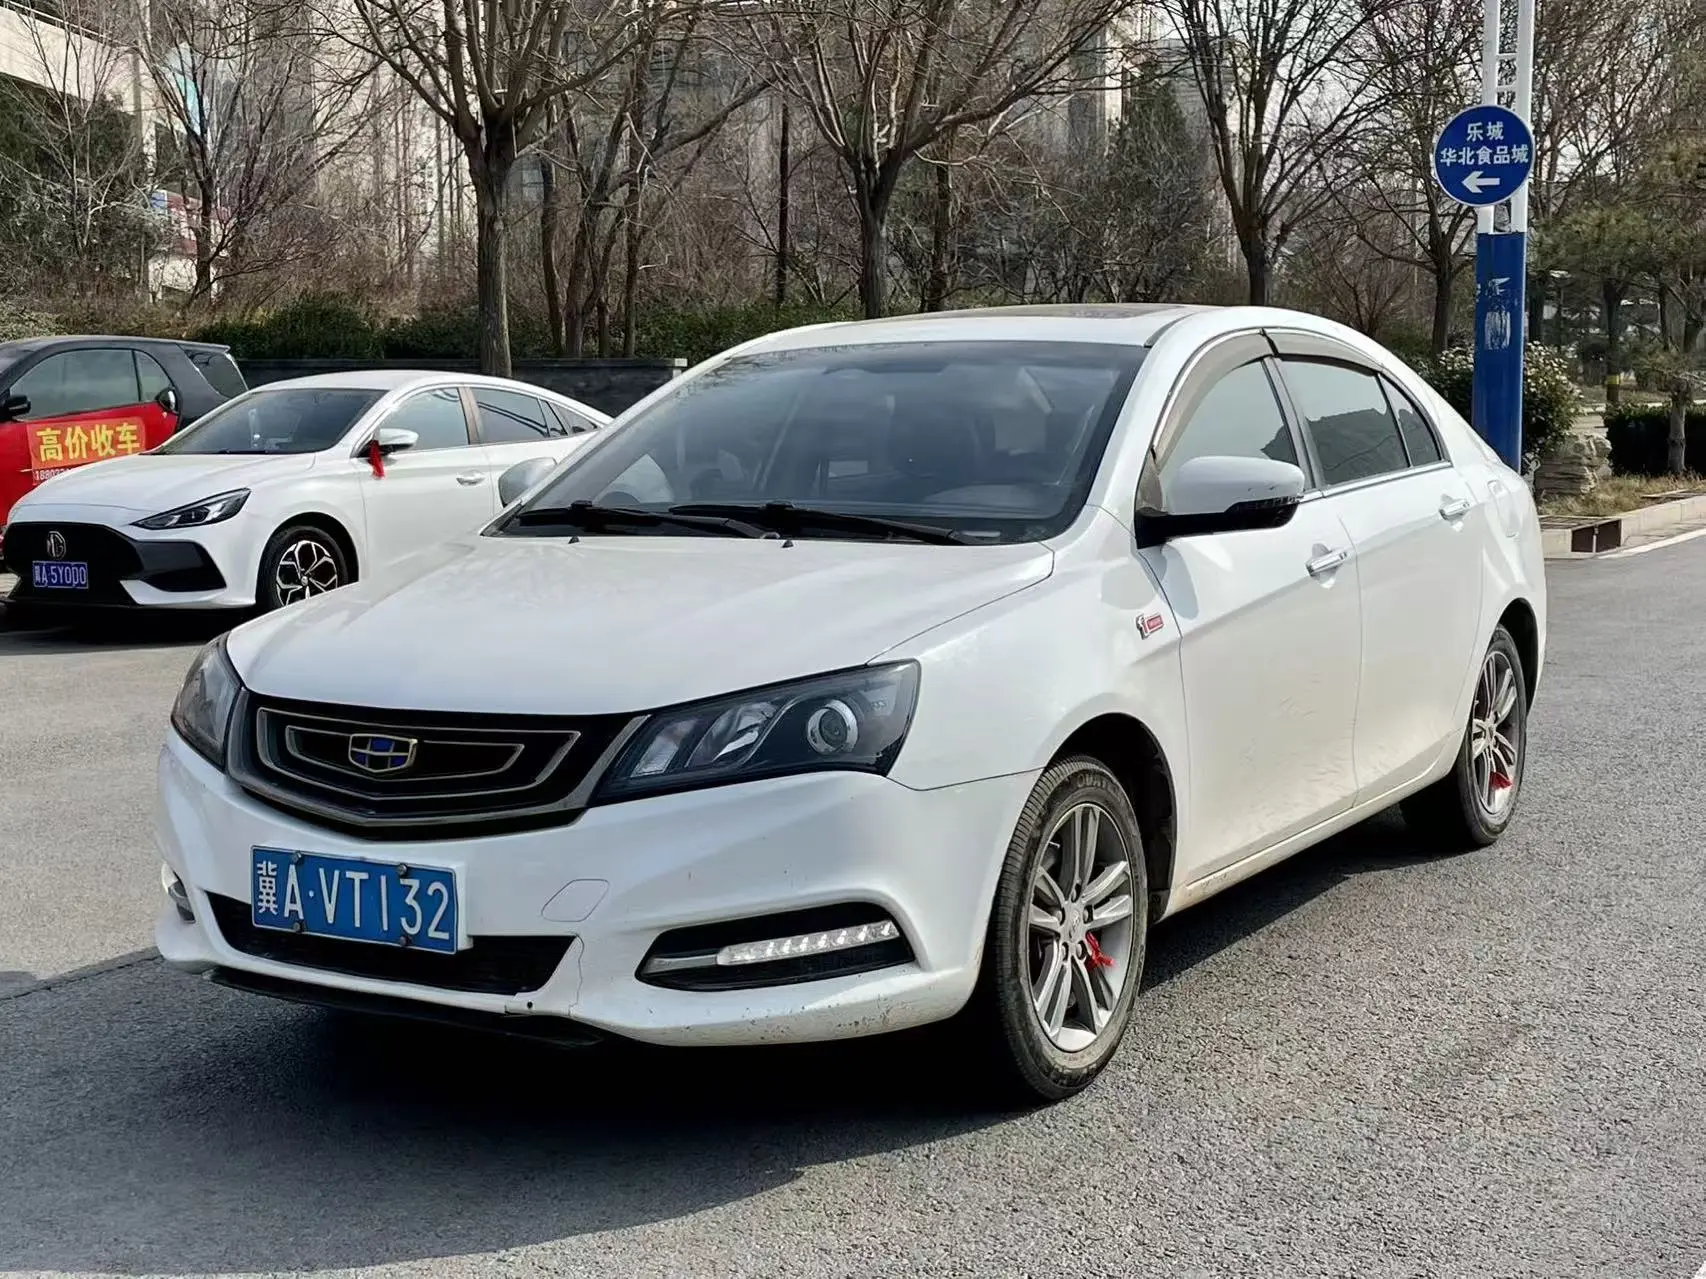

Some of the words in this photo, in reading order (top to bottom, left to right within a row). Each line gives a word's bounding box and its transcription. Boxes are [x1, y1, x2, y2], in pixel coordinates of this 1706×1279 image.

[1466, 121, 1504, 142] 乐城
[1440, 144, 1529, 167] 华北食品城
[36, 422, 141, 462] 高价收车
